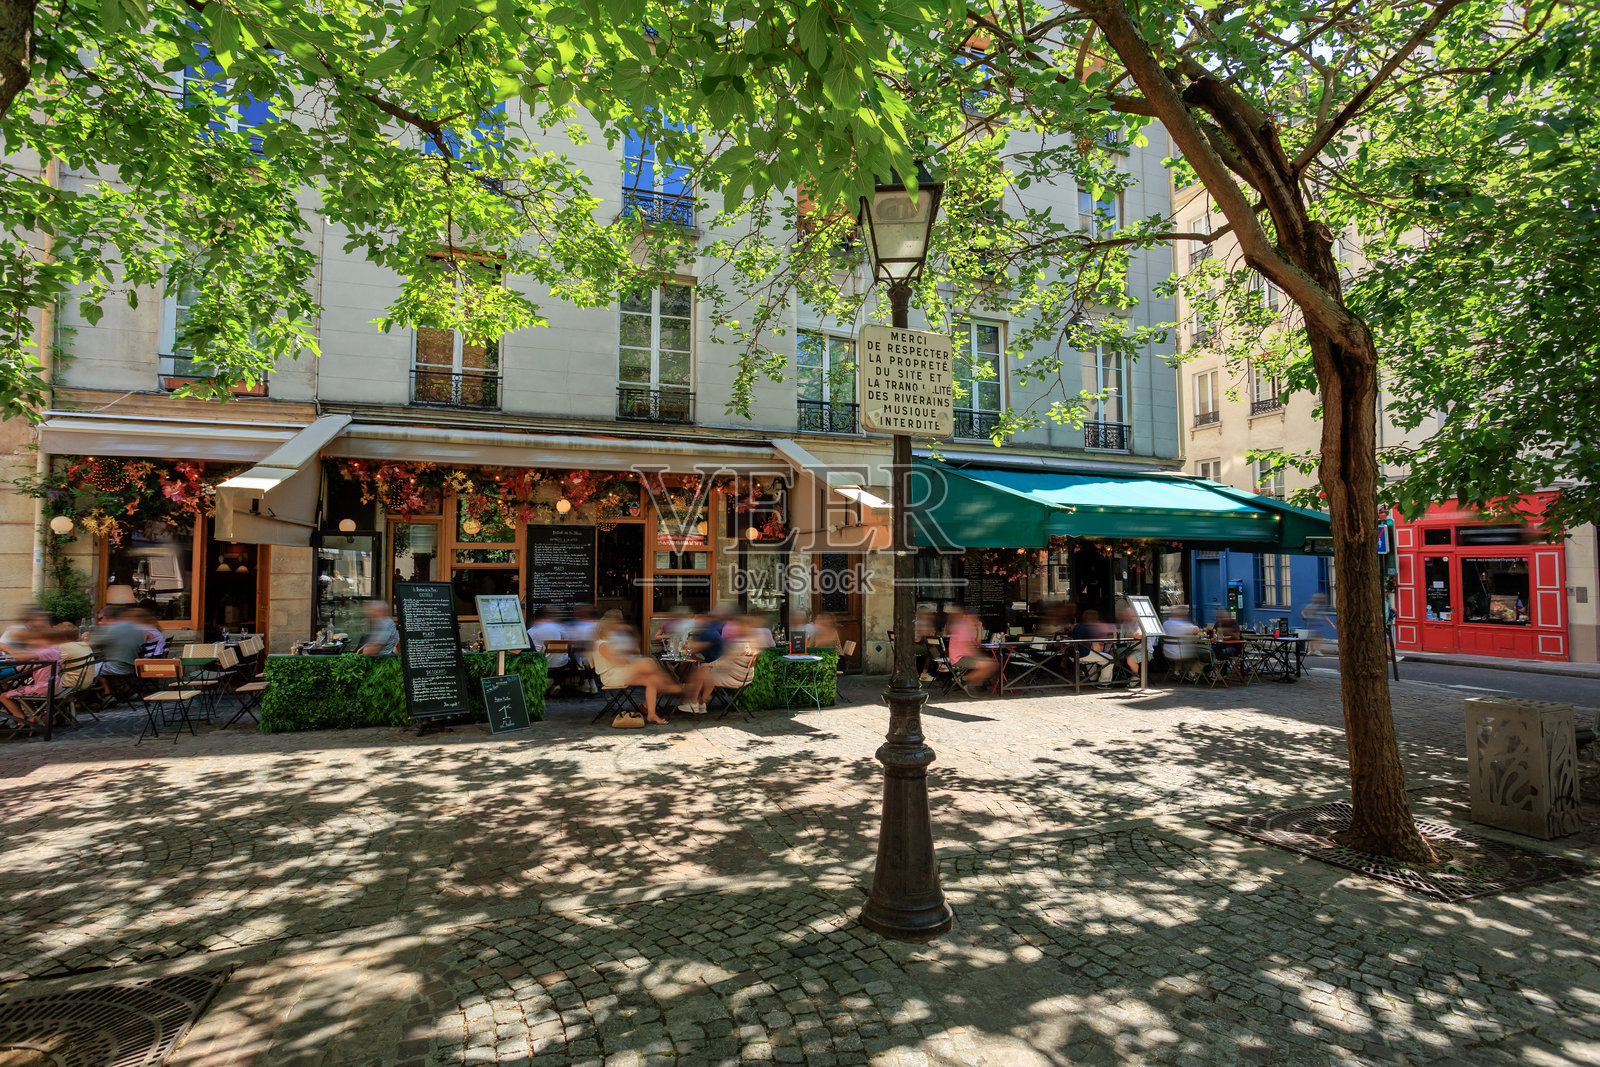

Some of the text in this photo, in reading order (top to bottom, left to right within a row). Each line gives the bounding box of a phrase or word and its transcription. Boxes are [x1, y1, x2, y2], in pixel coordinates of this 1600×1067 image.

[891, 331, 927, 345] MERCI
[867, 341, 949, 360] DE RESPECTER
[869, 353, 948, 372] LA PROPRETÉ
[876, 366, 942, 383] DU SITE ET
[868, 378, 952, 396] LA TRANQLITÉ
[868, 390, 950, 408] DES RIVERAINS
[883, 404, 936, 418] MUSIQUE
[880, 417, 940, 431] INTERDITE
